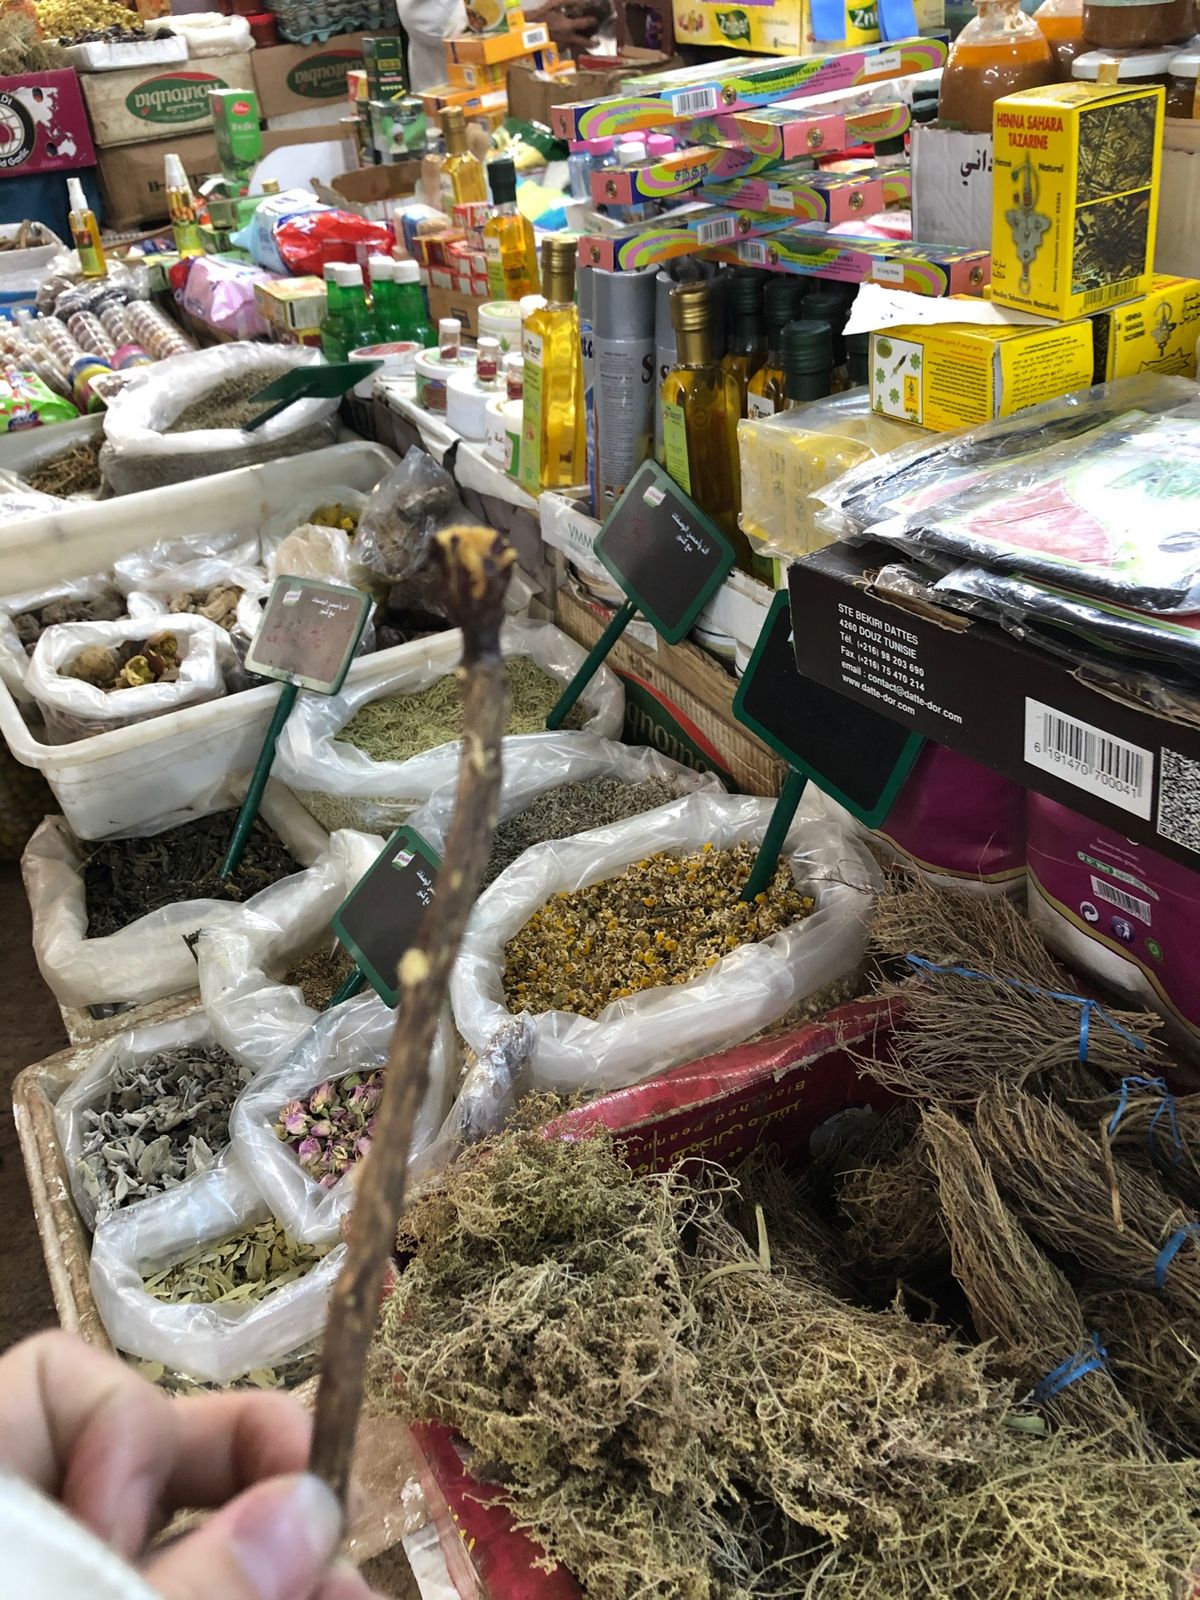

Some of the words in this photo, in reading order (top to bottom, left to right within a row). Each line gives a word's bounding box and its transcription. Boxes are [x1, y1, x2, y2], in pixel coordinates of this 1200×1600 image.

[996, 113, 1025, 129] HENNA
[1027, 115, 1063, 132] SAHARA
[1008, 133, 1049, 150] TAZARINE
[838, 603, 854, 617] STE
[855, 611, 883, 629] BEKIRI
[884, 623, 918, 645] DATTES
[839, 619, 857, 632] 4260
[859, 626, 882, 643] DOUZ
[883, 636, 917, 659] TUNISIE
[840, 631, 853, 645] Tél.
[857, 640, 879, 657] (+216)
[881, 650, 890, 661] 98
[893, 656, 907, 669] 203
[909, 664, 924, 677] 690
[840, 645, 856, 660] Fax.
[857, 655, 879, 671] (+216)
[882, 665, 891, 676] 75
[893, 671, 907, 683] 470
[910, 678, 925, 691] 214
[841, 661, 861, 675] email
[867, 673, 962, 724] contact@datte-dor.com
[842, 674, 915, 715] www.datte-dor.com
[1034, 742, 1041, 753] 6
[1049, 748, 1088, 775] 191470
[1095, 770, 1136, 798] 700041
